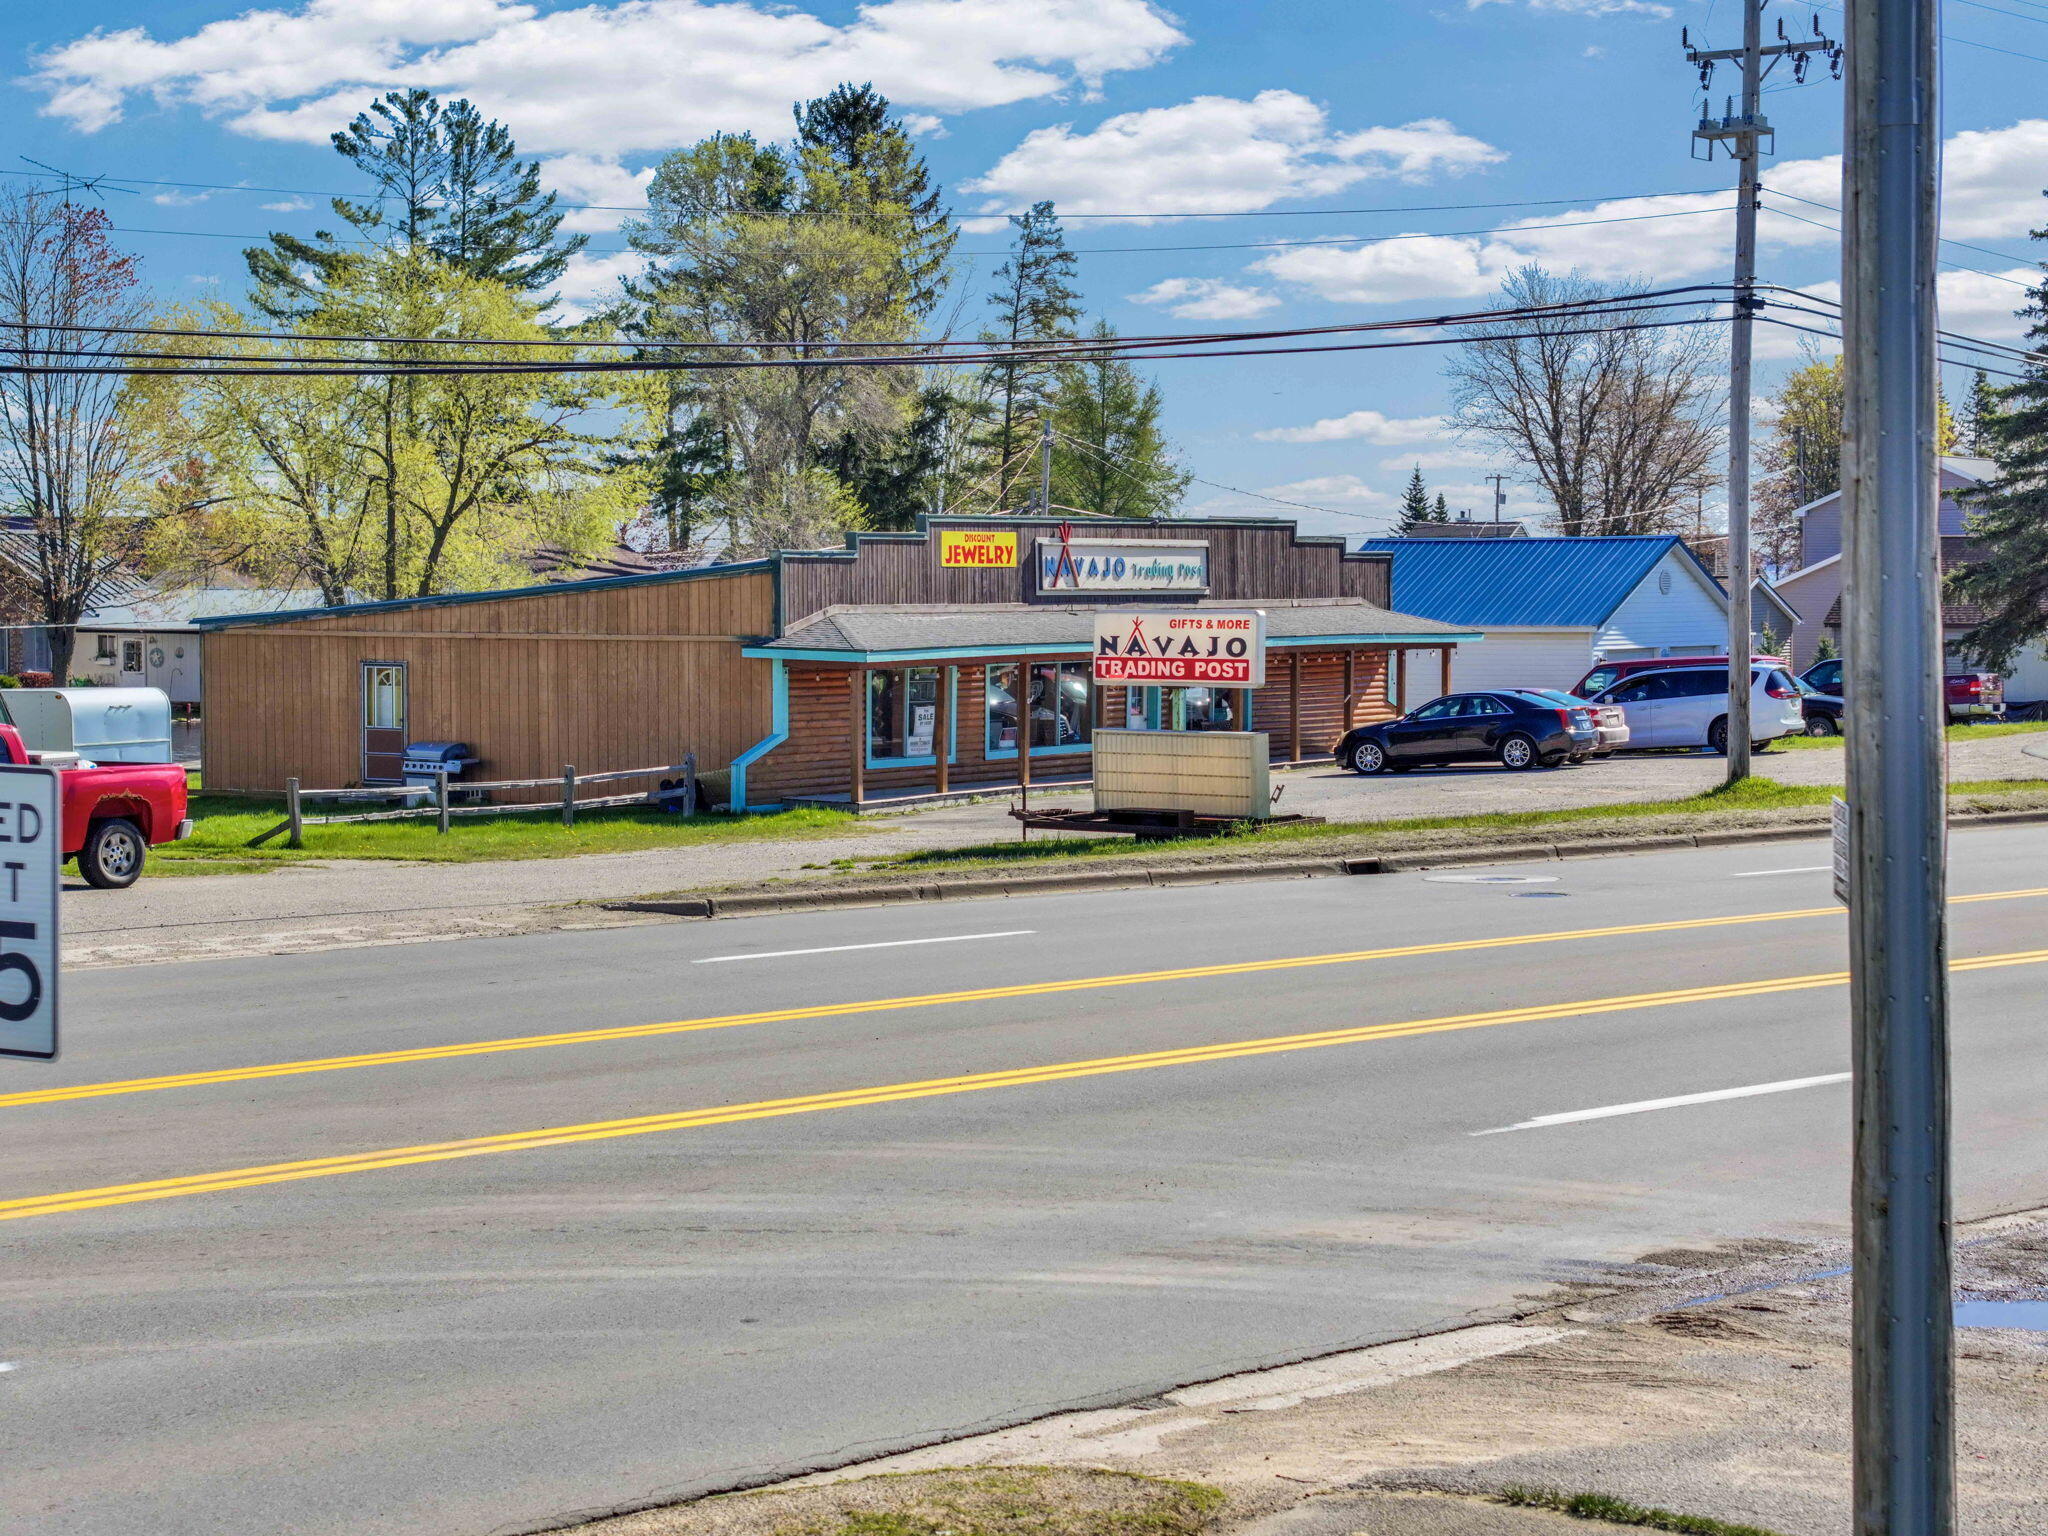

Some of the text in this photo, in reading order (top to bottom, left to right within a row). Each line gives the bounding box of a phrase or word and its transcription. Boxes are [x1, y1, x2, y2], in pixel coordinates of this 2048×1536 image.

[964, 534, 995, 543] DISCOUNT
[945, 545, 1014, 564] JEWELRY
[1044, 556, 1126, 577] NAVAJO
[1169, 619, 1250, 630] GIFTS & MORE
[1098, 635, 1247, 658] NAVAJO
[1097, 660, 1248, 678] TRADING POST
[918, 713, 934, 721] SALE
